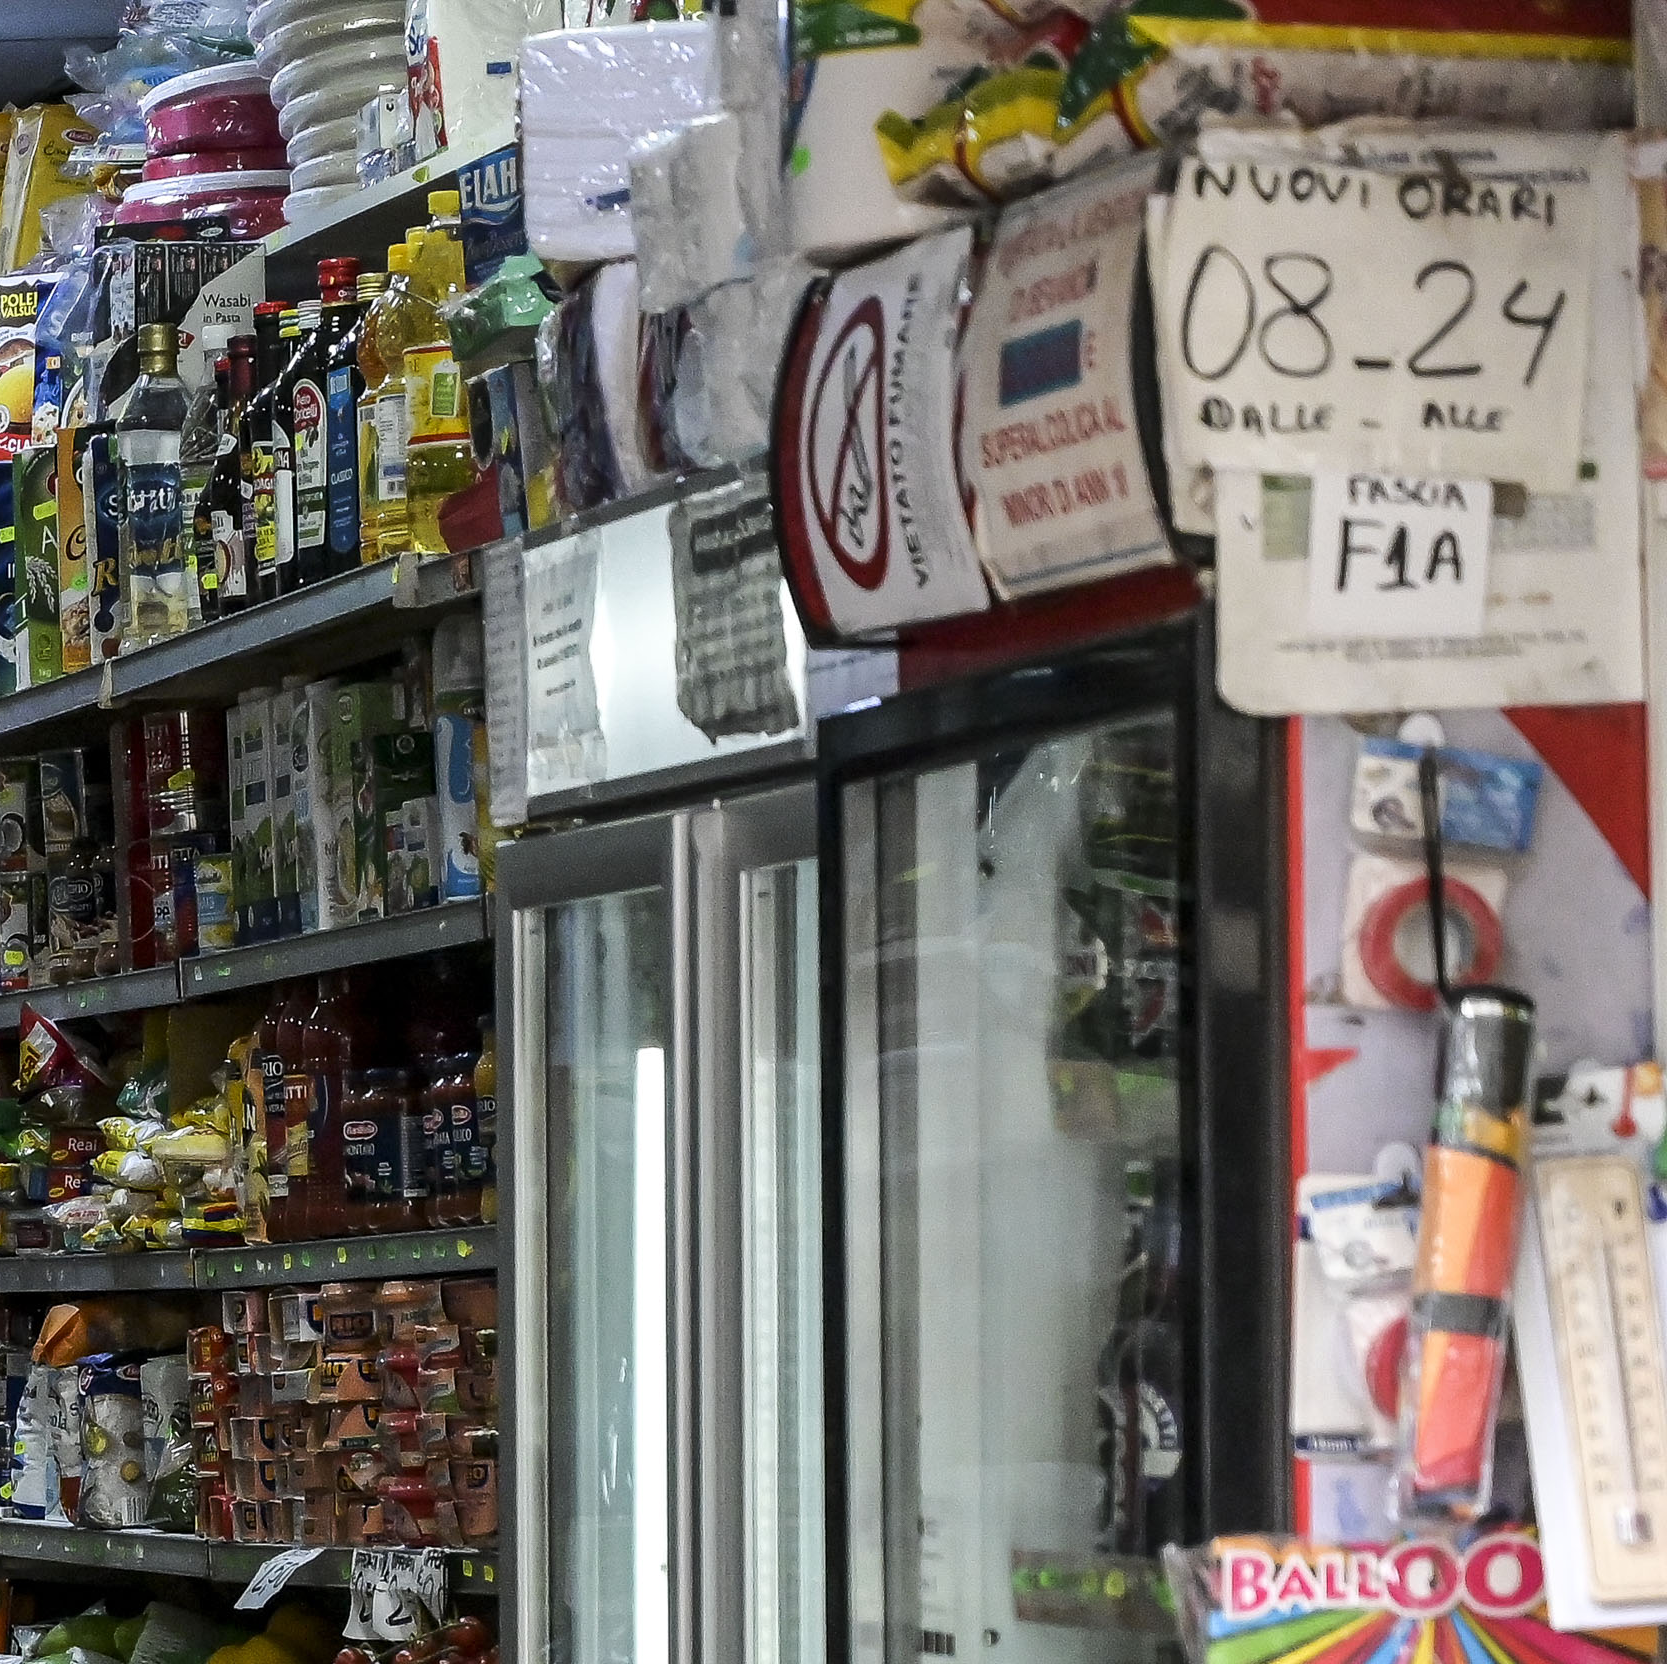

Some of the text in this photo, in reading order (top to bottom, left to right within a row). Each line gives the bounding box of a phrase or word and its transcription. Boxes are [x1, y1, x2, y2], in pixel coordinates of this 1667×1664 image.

[1193, 164, 1557, 228] NUOVI ORARI
[202, 294, 252, 308] Wasabi
[202, 311, 242, 323] in Pasta
[887, 271, 930, 590] VIETATO FUMARE
[1200, 398, 1334, 434] DALLE
[1420, 402, 1511, 434] ALLE
[1346, 474, 1468, 506] FASCIA
[1334, 517, 1466, 593] F1A
[67, 1136, 98, 1154] Real
